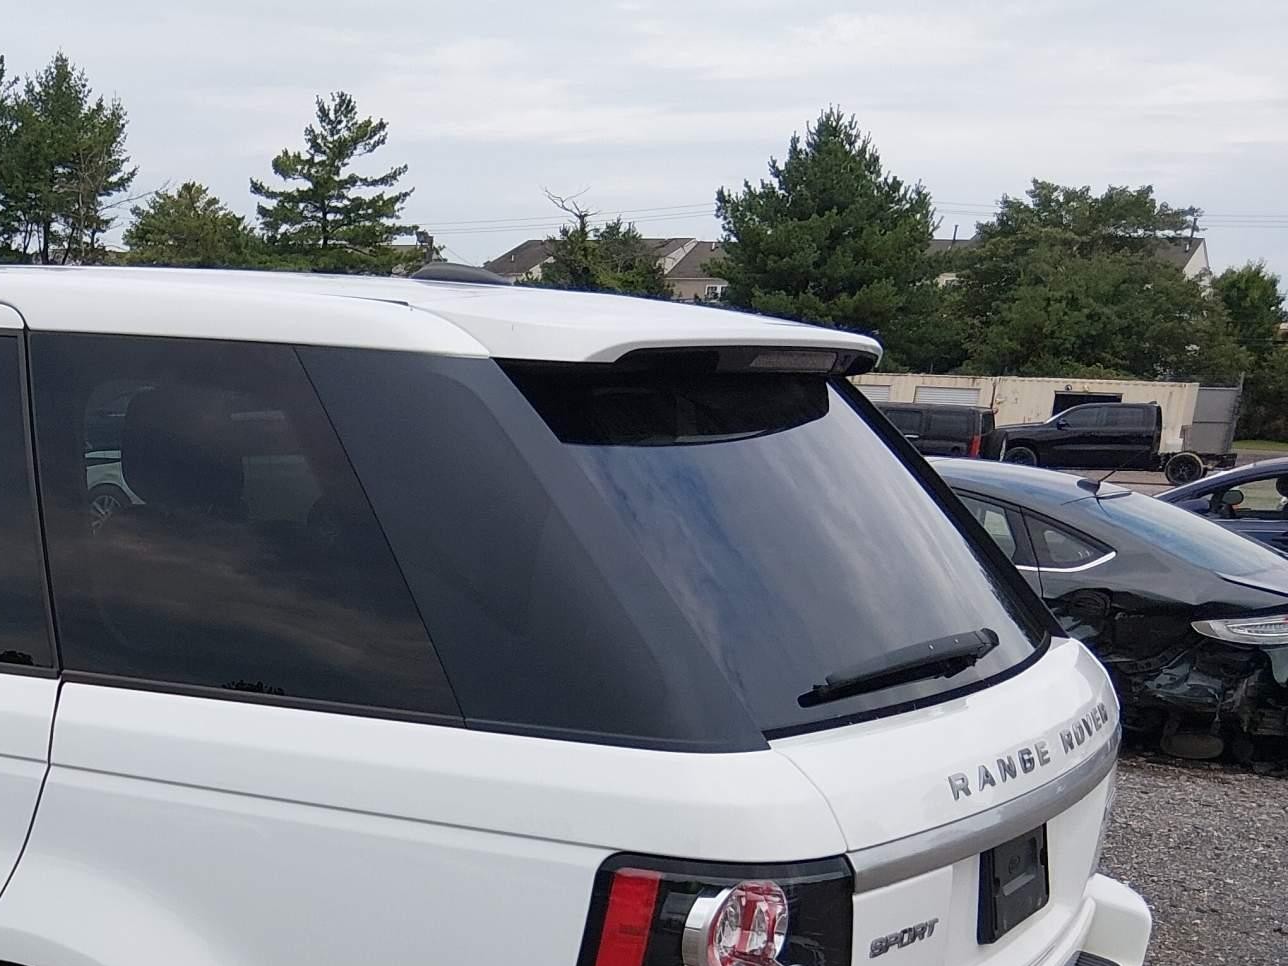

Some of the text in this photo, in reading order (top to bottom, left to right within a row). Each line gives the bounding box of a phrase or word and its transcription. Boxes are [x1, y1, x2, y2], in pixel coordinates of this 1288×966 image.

[948, 702, 1109, 801] RANGE ROVER
[869, 917, 939, 959] SPORT
